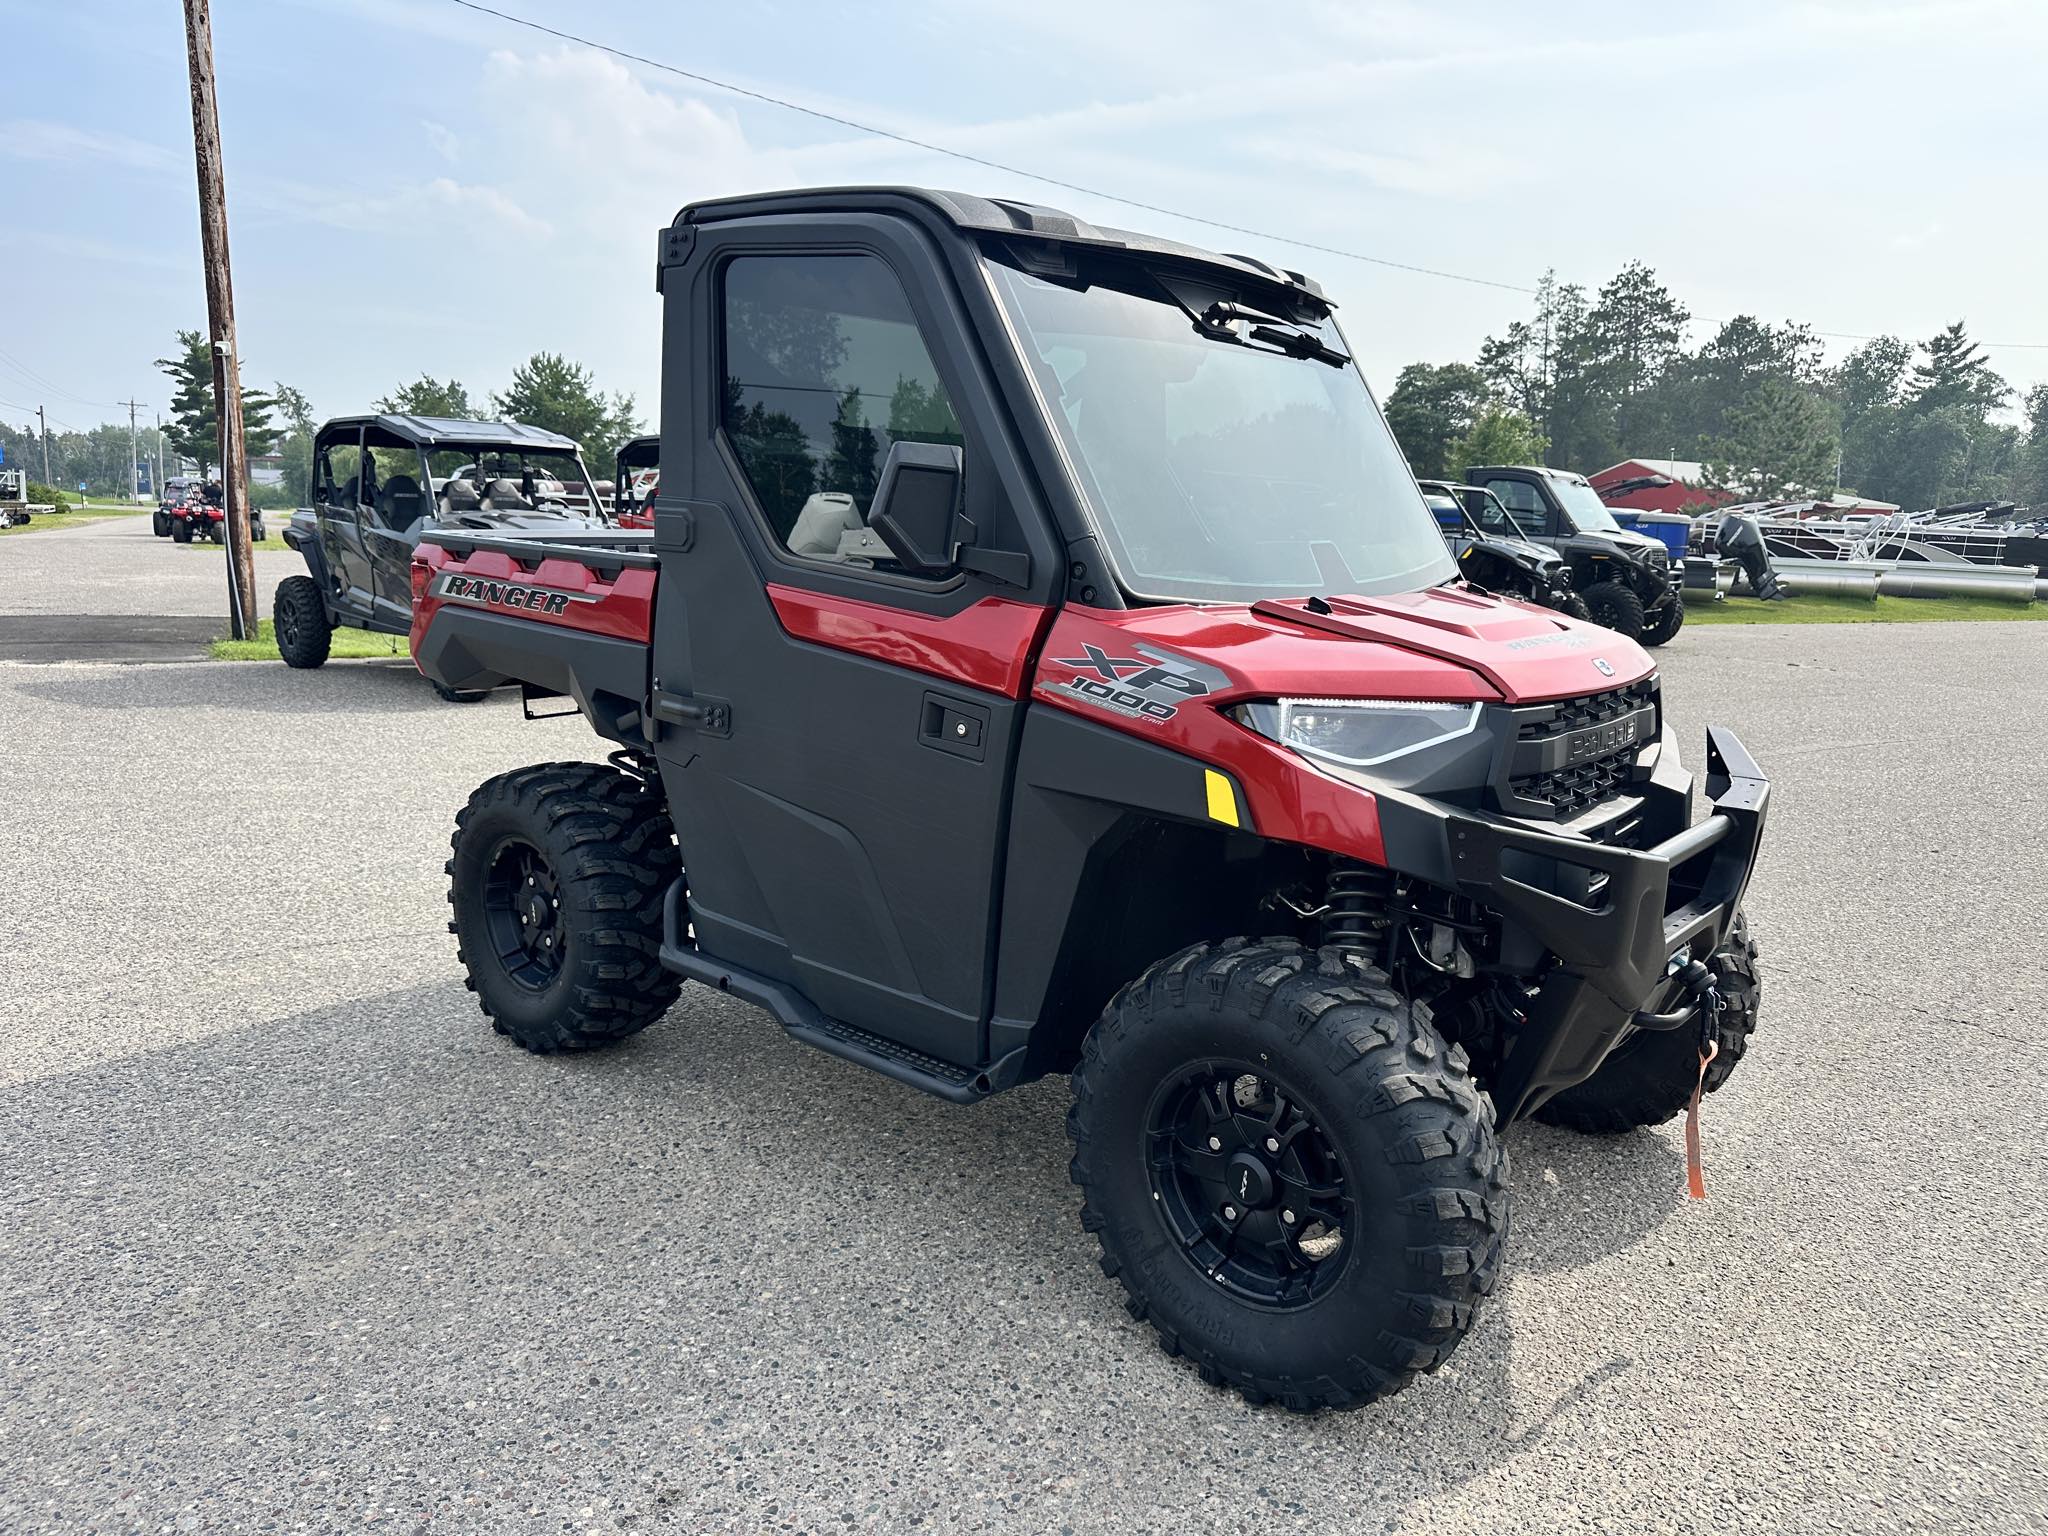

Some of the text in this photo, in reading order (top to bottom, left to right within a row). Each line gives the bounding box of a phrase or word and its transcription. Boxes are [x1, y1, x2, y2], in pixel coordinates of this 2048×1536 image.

[445, 575, 569, 616] RANGER
[1048, 642, 1210, 696] XP
[1066, 690, 1089, 702] DUAL
[1141, 715, 1165, 726] CAM
[1069, 676, 1178, 720] 1000
[1568, 719, 1636, 760] POLARIS
